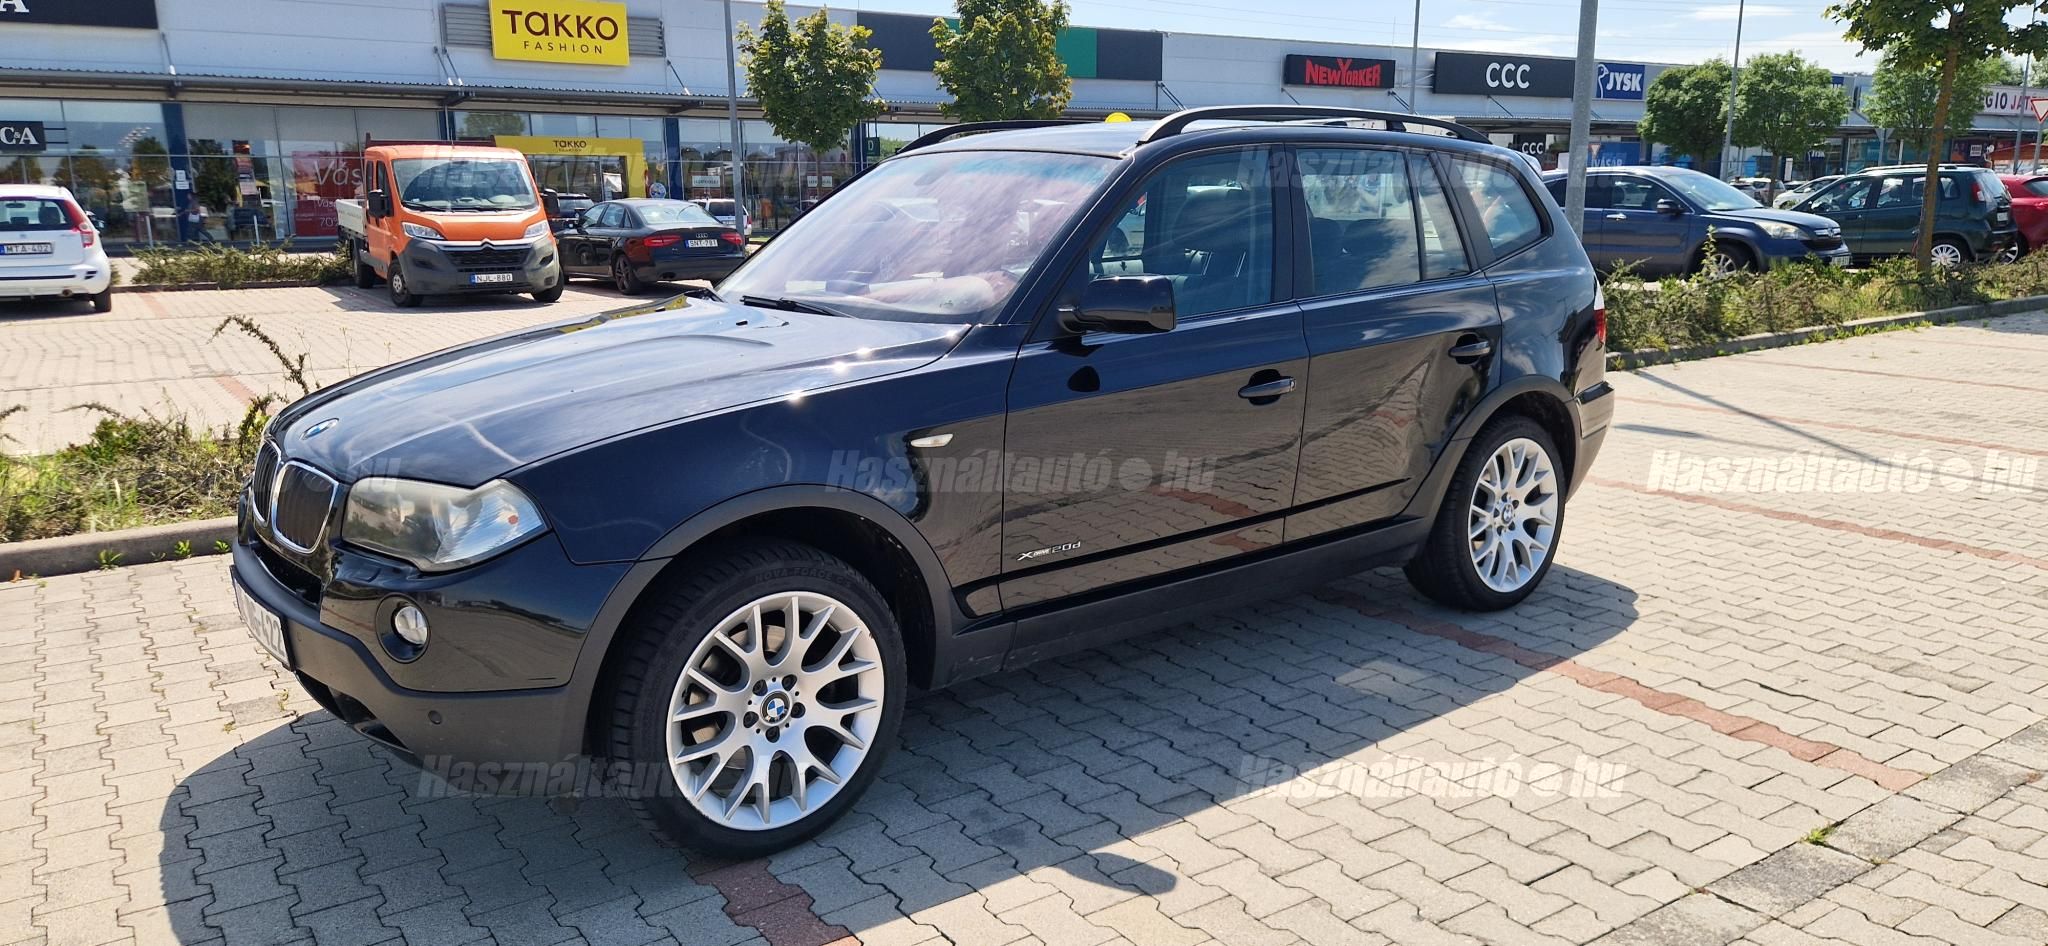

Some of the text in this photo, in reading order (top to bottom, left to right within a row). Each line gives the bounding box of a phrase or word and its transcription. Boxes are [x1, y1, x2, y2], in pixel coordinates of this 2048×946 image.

[524, 41, 602, 54] FASHION
[1486, 62, 1530, 89] CCC
[1606, 72, 1643, 92] JYSK
[0, 127, 39, 145] C&A
[1521, 142, 1544, 155] CCC
